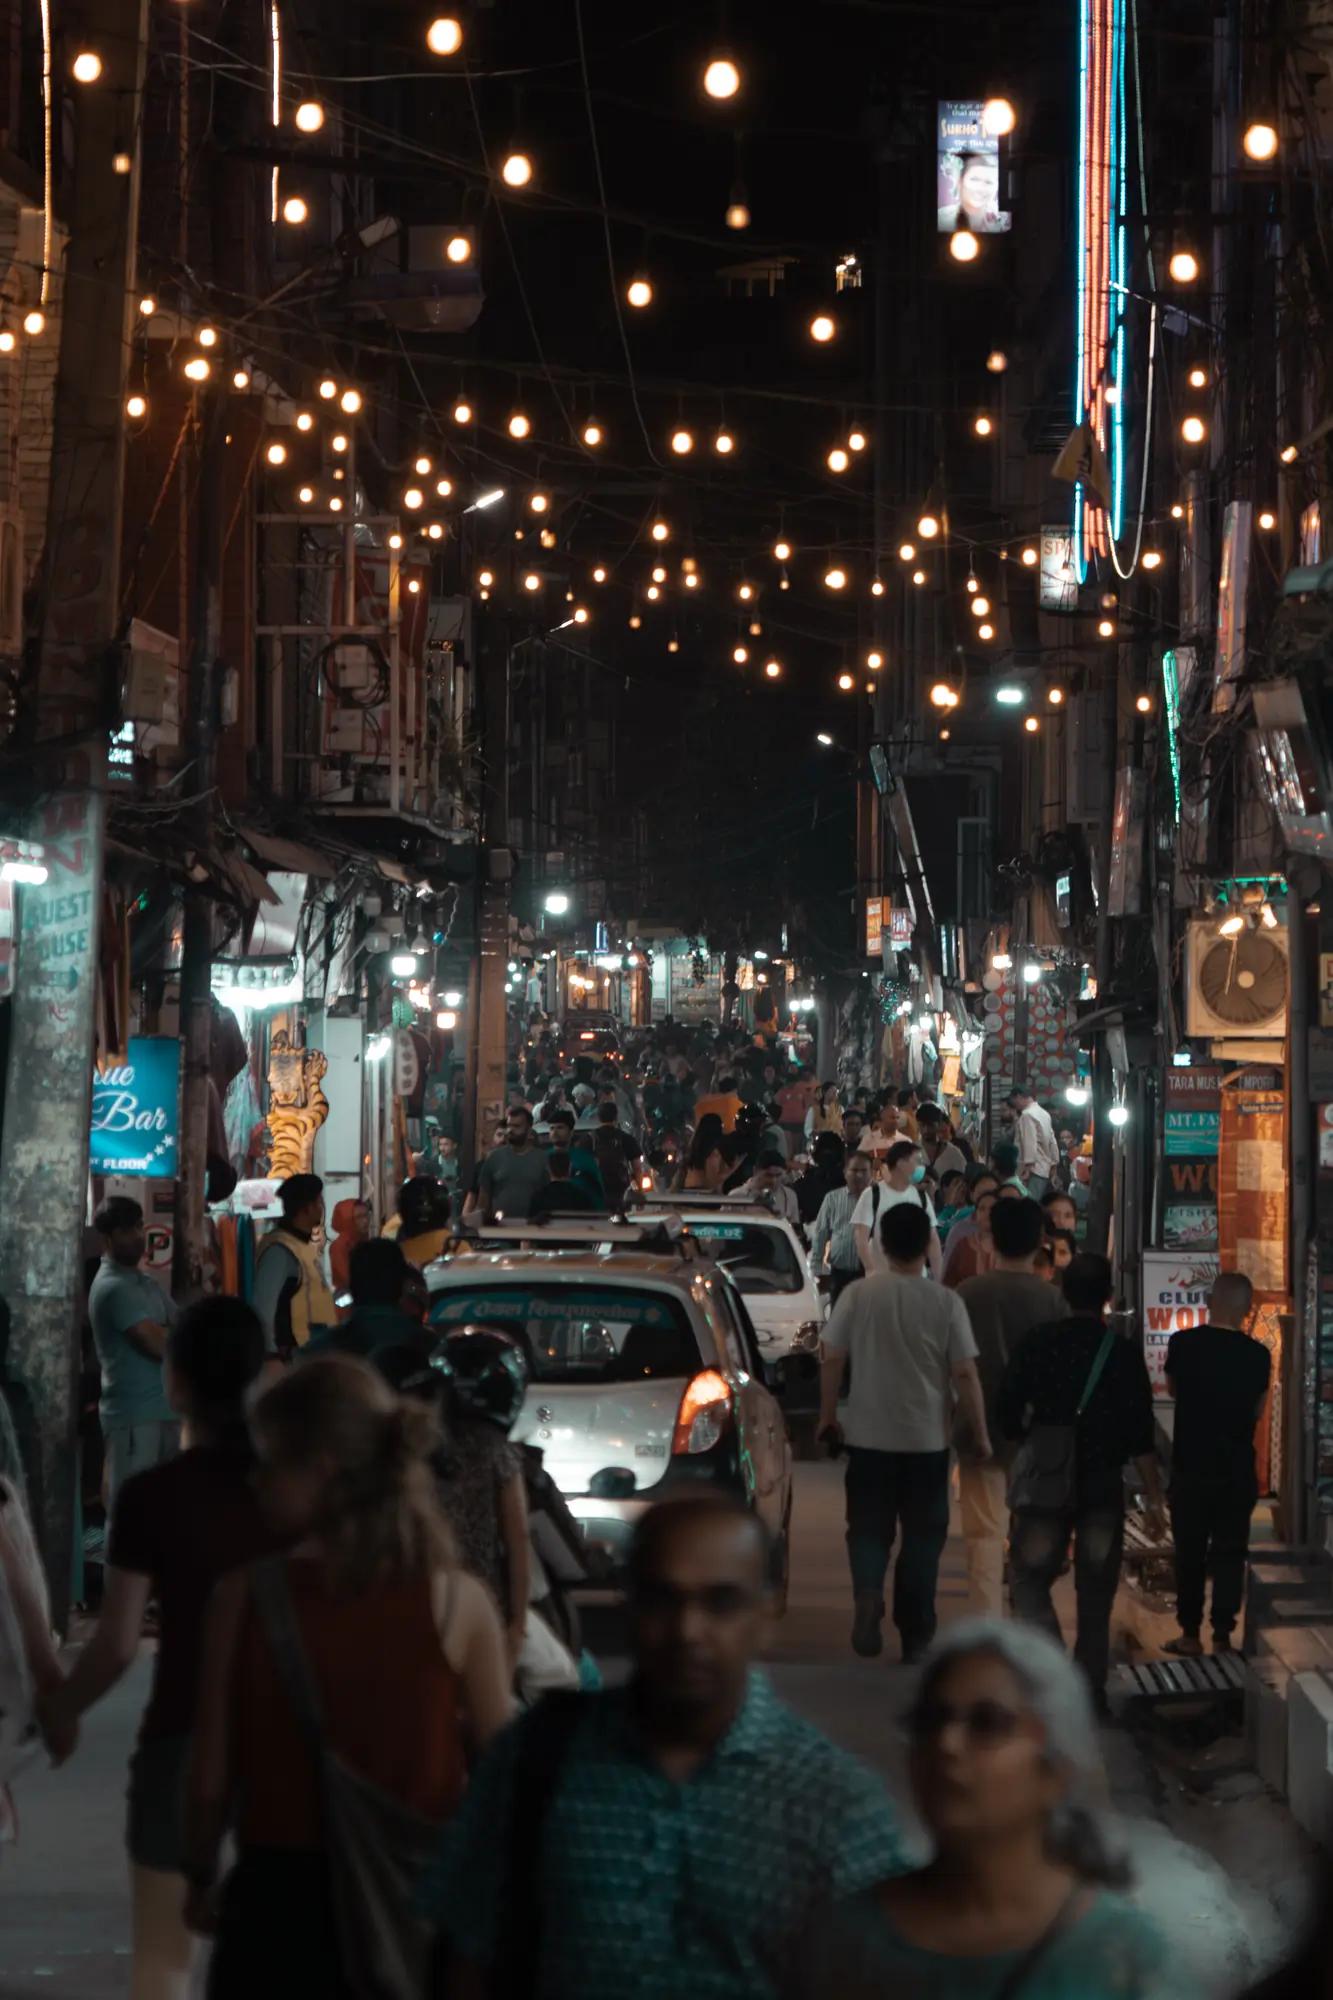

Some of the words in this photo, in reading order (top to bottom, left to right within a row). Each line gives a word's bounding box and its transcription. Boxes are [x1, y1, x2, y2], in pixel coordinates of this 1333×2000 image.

[91, 1090, 168, 1132] Bar
[1167, 1113, 1195, 1127] MT.
[103, 1157, 147, 1170] FLOOR
